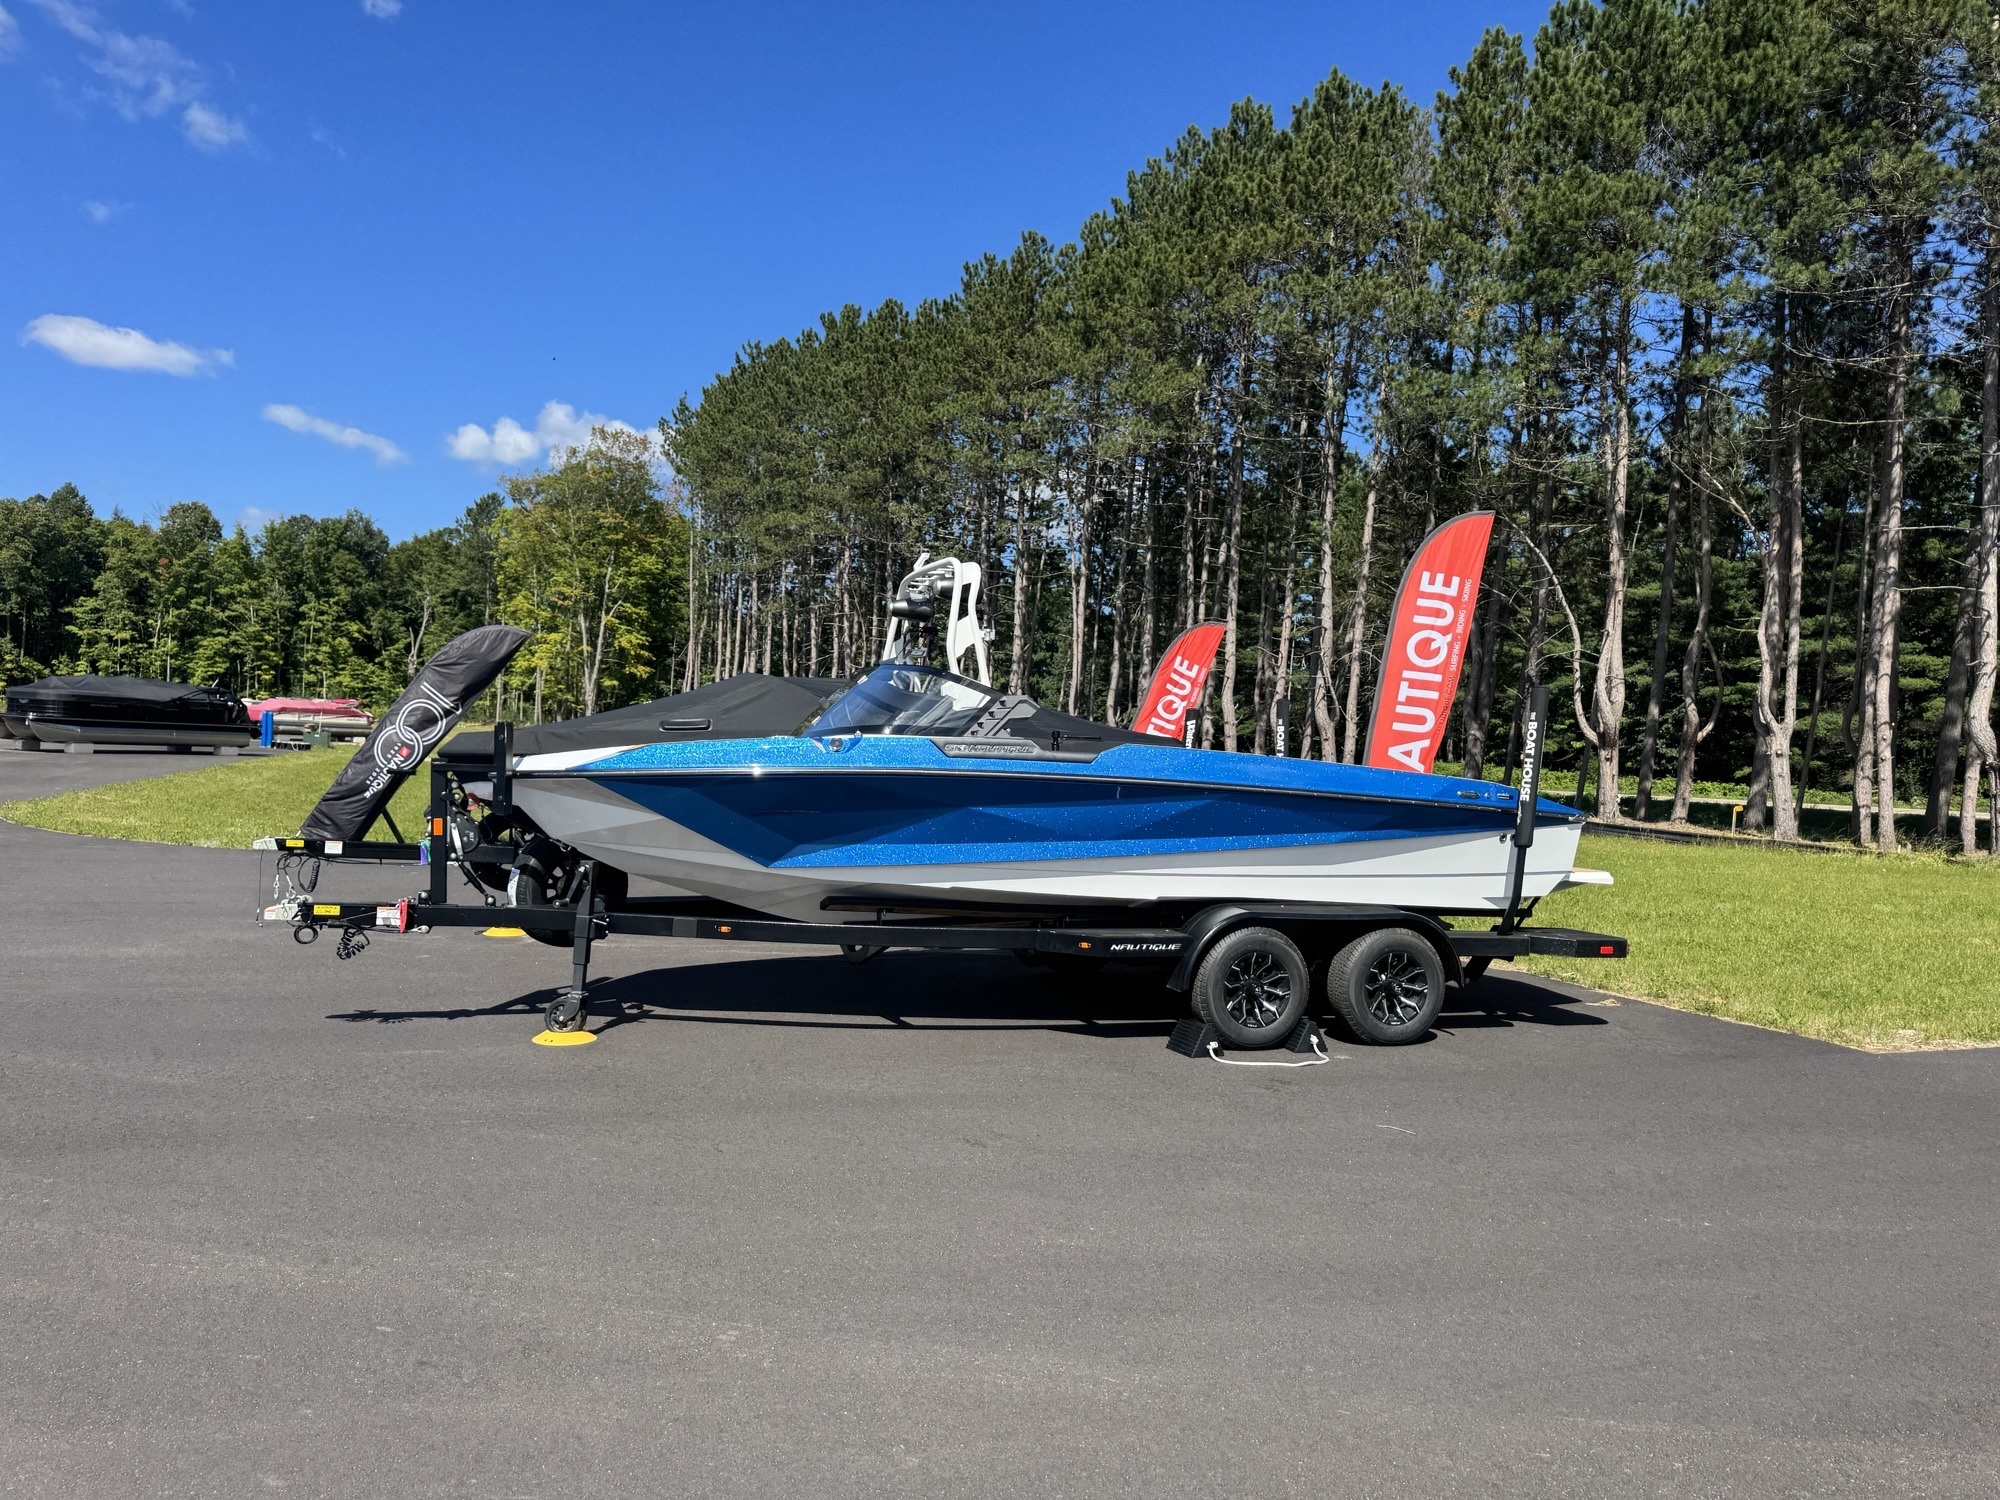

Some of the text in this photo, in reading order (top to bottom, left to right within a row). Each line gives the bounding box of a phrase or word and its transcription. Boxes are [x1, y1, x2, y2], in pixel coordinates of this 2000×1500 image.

[1461, 578, 1473, 603] SKIING
[1456, 609, 1467, 634] RIDING
[1449, 641, 1461, 672] SURFING
[1276, 725, 1285, 752] BOAT
[1525, 721, 1538, 756] BOAT
[1520, 758, 1534, 802] HOUSE
[1110, 943, 1182, 951] NAUTIQUE
